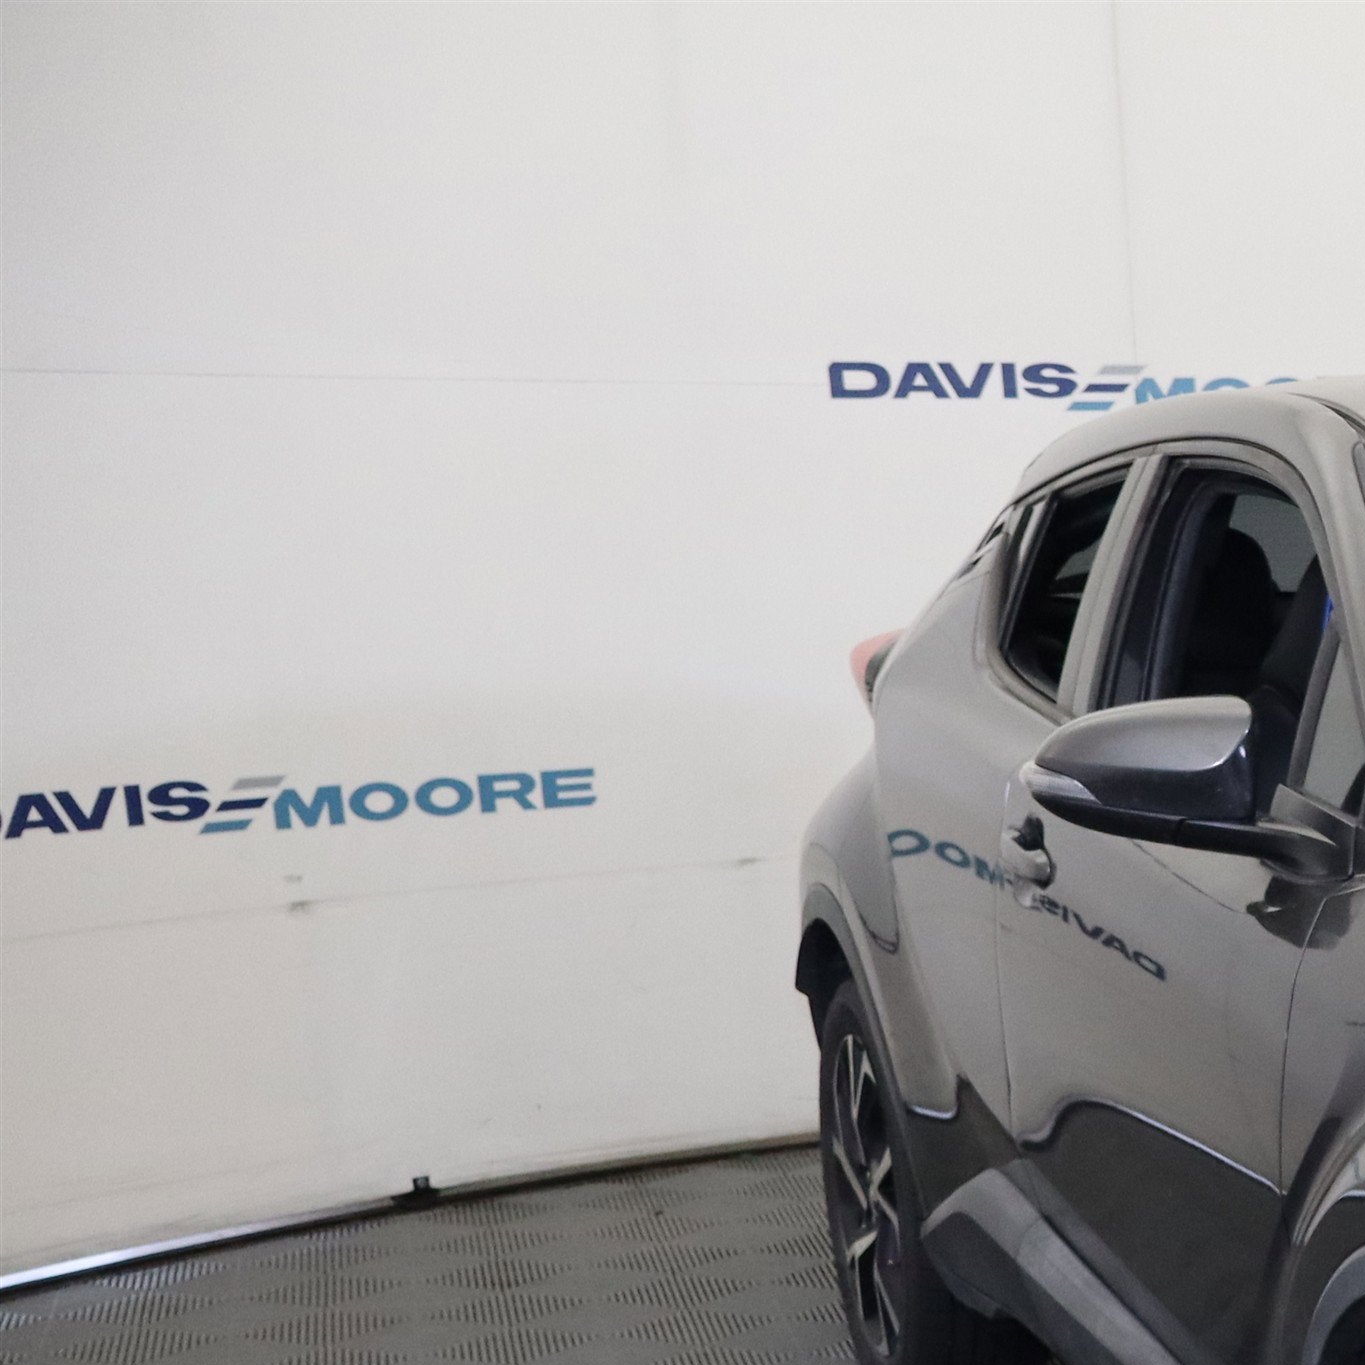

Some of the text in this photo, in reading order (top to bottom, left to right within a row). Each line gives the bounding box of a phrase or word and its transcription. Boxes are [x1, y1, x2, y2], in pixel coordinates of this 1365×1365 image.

[827, 361, 1079, 400] DAVIS
[0, 767, 598, 841] AVIS MOORE
